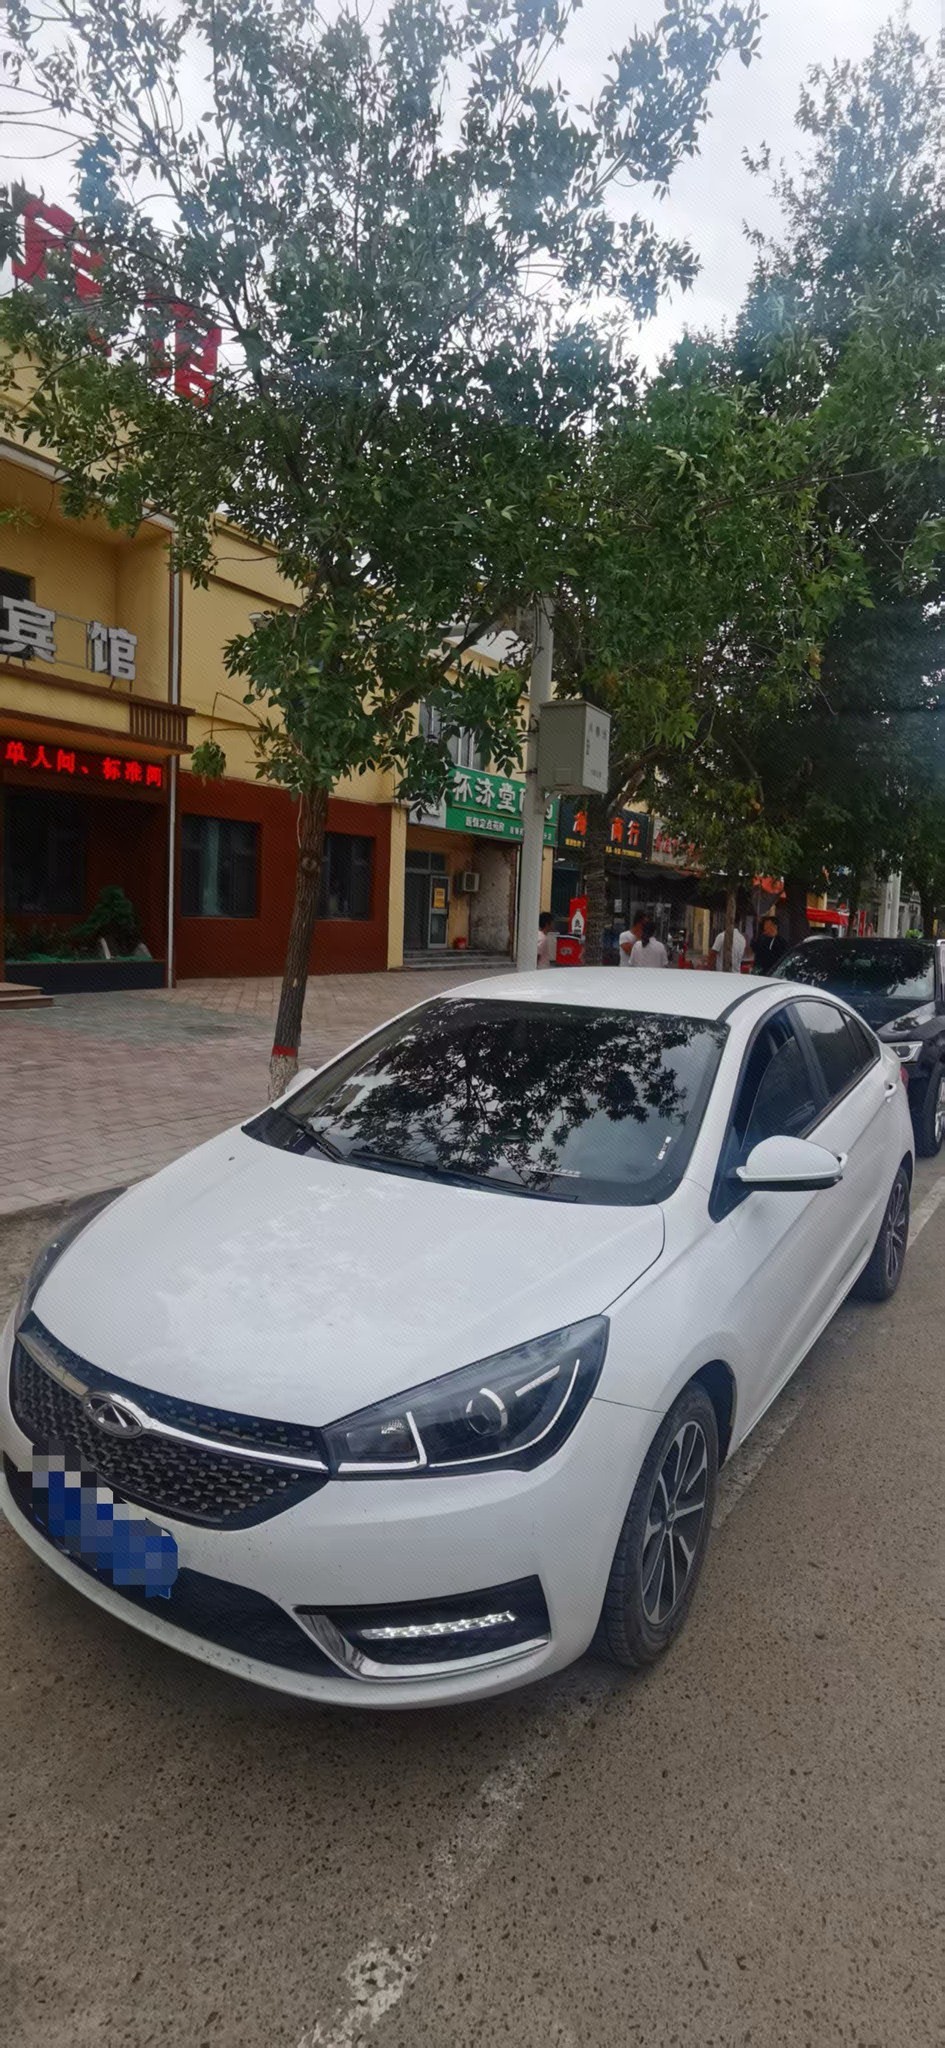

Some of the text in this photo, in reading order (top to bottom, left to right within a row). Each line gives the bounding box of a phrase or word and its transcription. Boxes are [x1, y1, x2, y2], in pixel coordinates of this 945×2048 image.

[0, 595, 138, 680] 宾馆
[5, 741, 163, 788] 单人间、标准间
